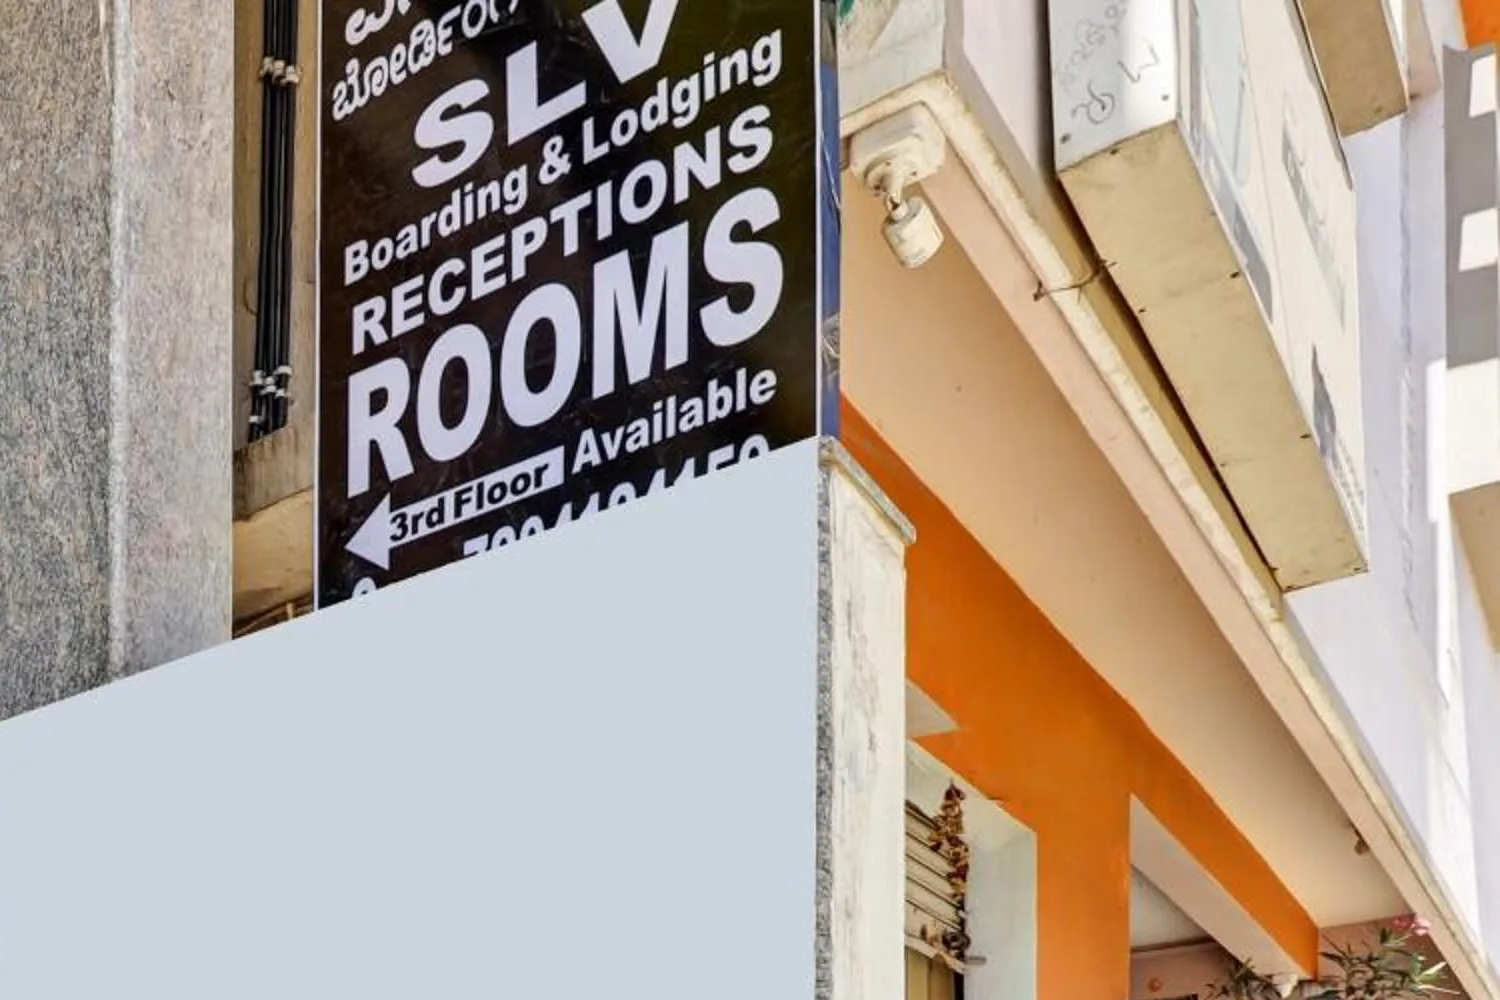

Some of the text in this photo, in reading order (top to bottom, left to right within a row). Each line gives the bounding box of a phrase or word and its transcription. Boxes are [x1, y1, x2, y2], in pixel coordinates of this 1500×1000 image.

[345, 29, 782, 286] Boarding & Lodging
[411, 0, 678, 188] SLV
[347, 187, 784, 498] ROOMS
[352, 104, 773, 355] RECEPTIONS
[389, 497, 446, 542] 3rd
[452, 463, 549, 520] Floor
[571, 367, 777, 474] Available
